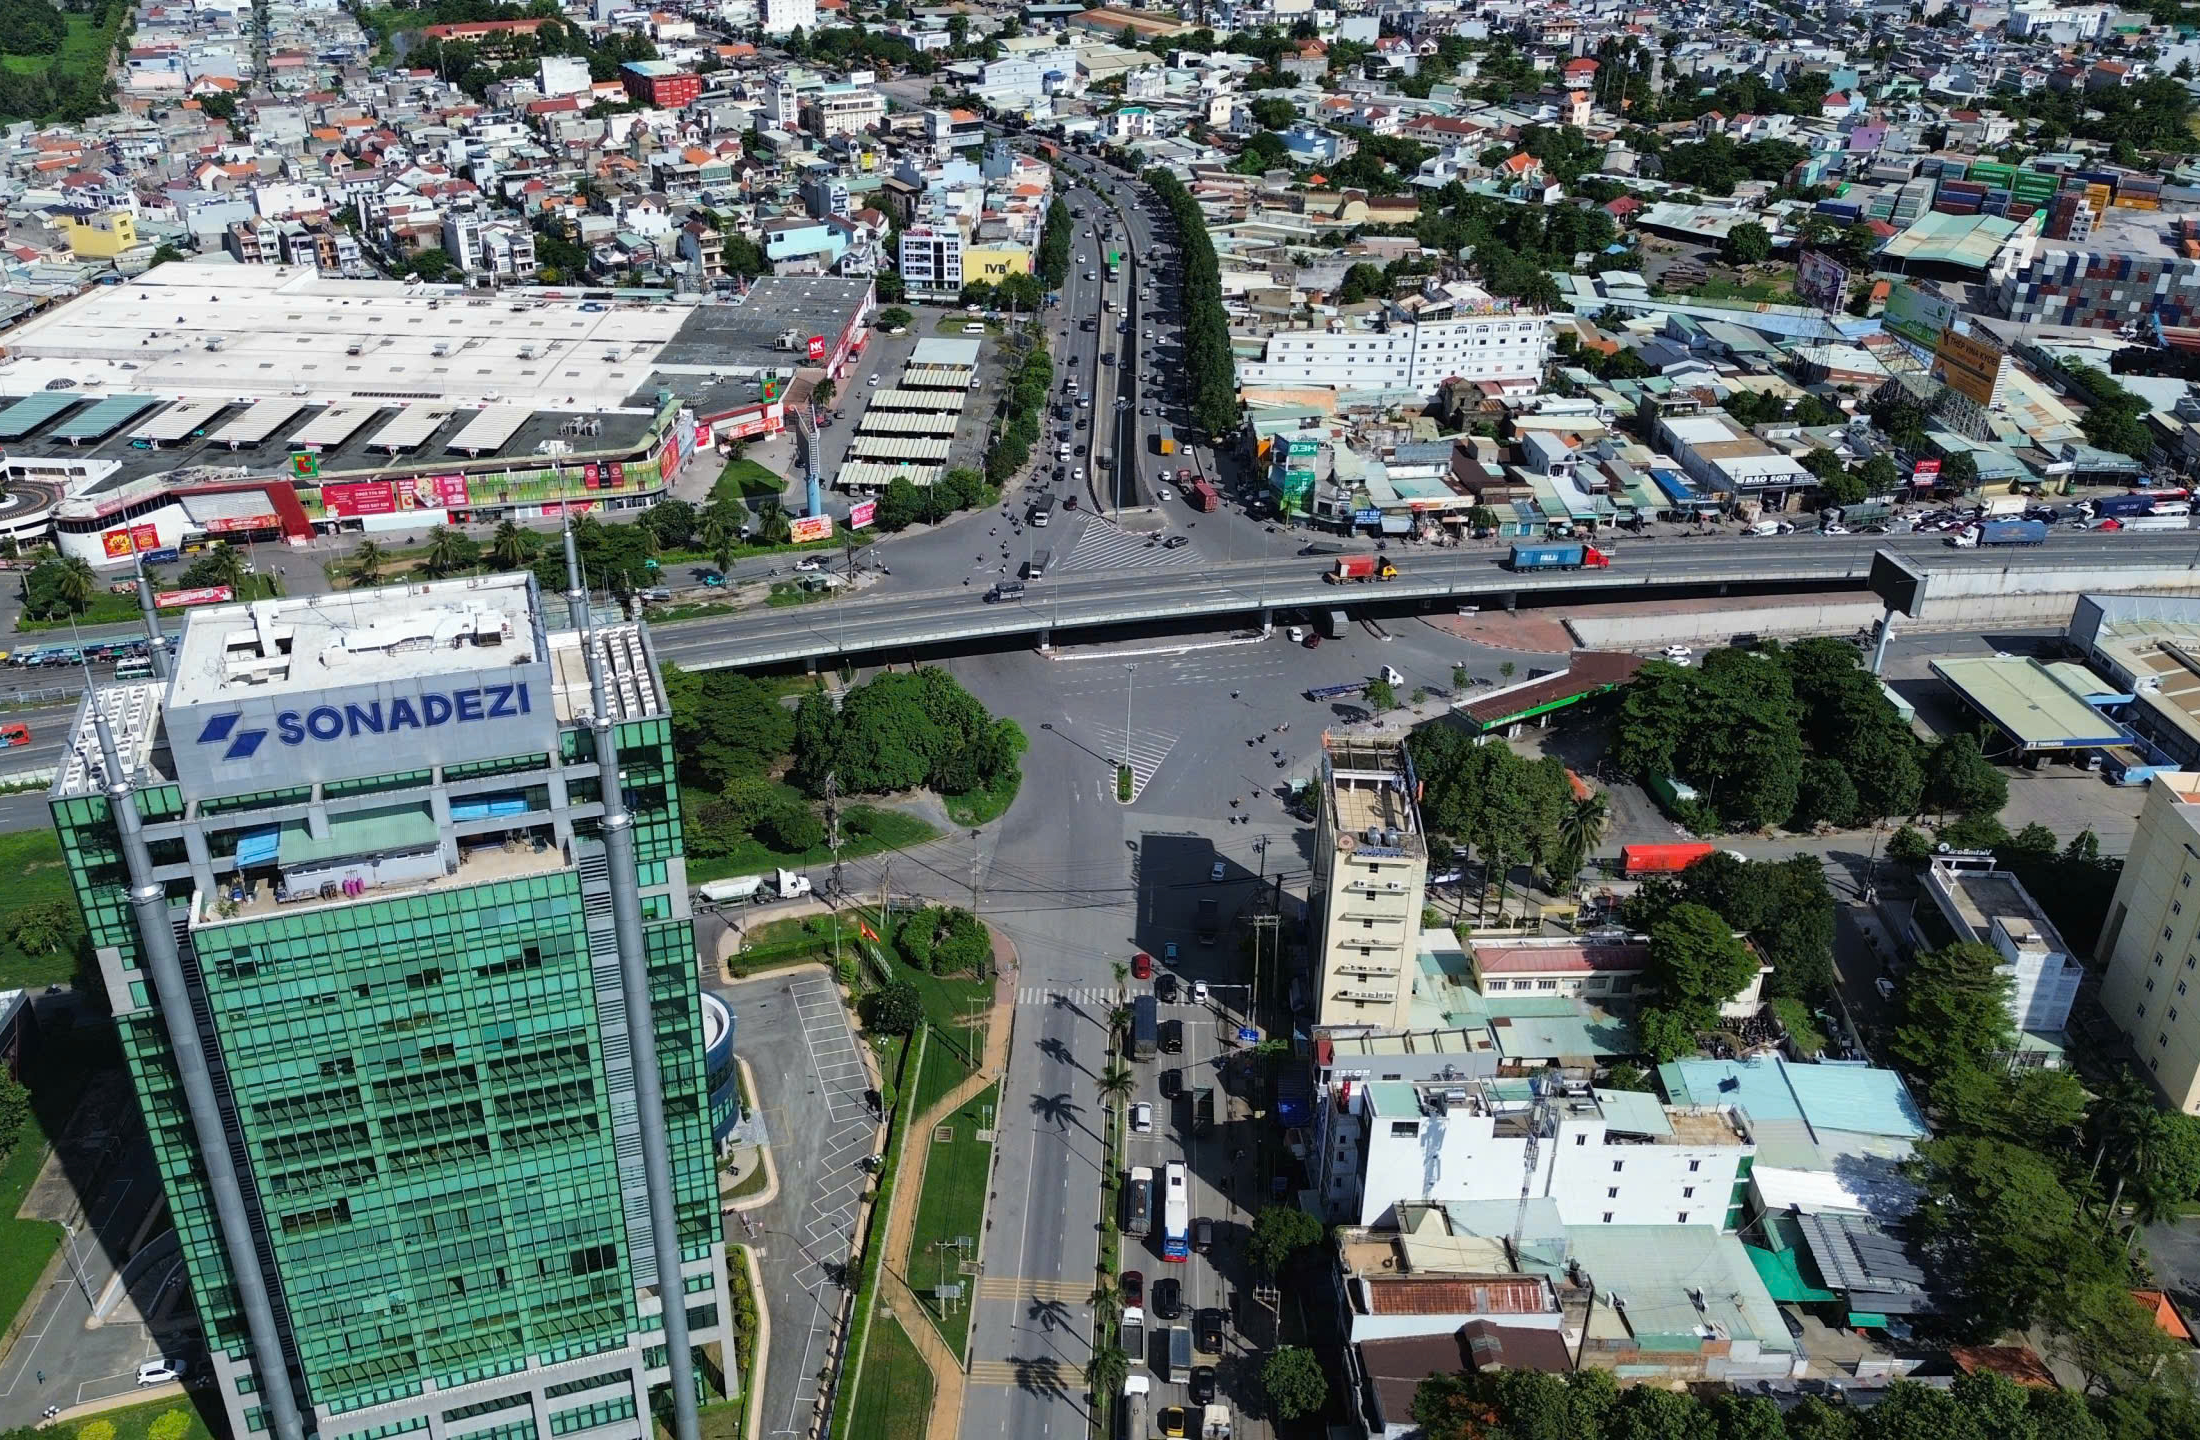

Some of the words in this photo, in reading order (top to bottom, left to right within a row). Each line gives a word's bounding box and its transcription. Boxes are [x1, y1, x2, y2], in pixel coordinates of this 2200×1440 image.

[984, 263, 1006, 274] IVB
[810, 341, 823, 352] NK
[276, 682, 531, 746] SONADEZI
